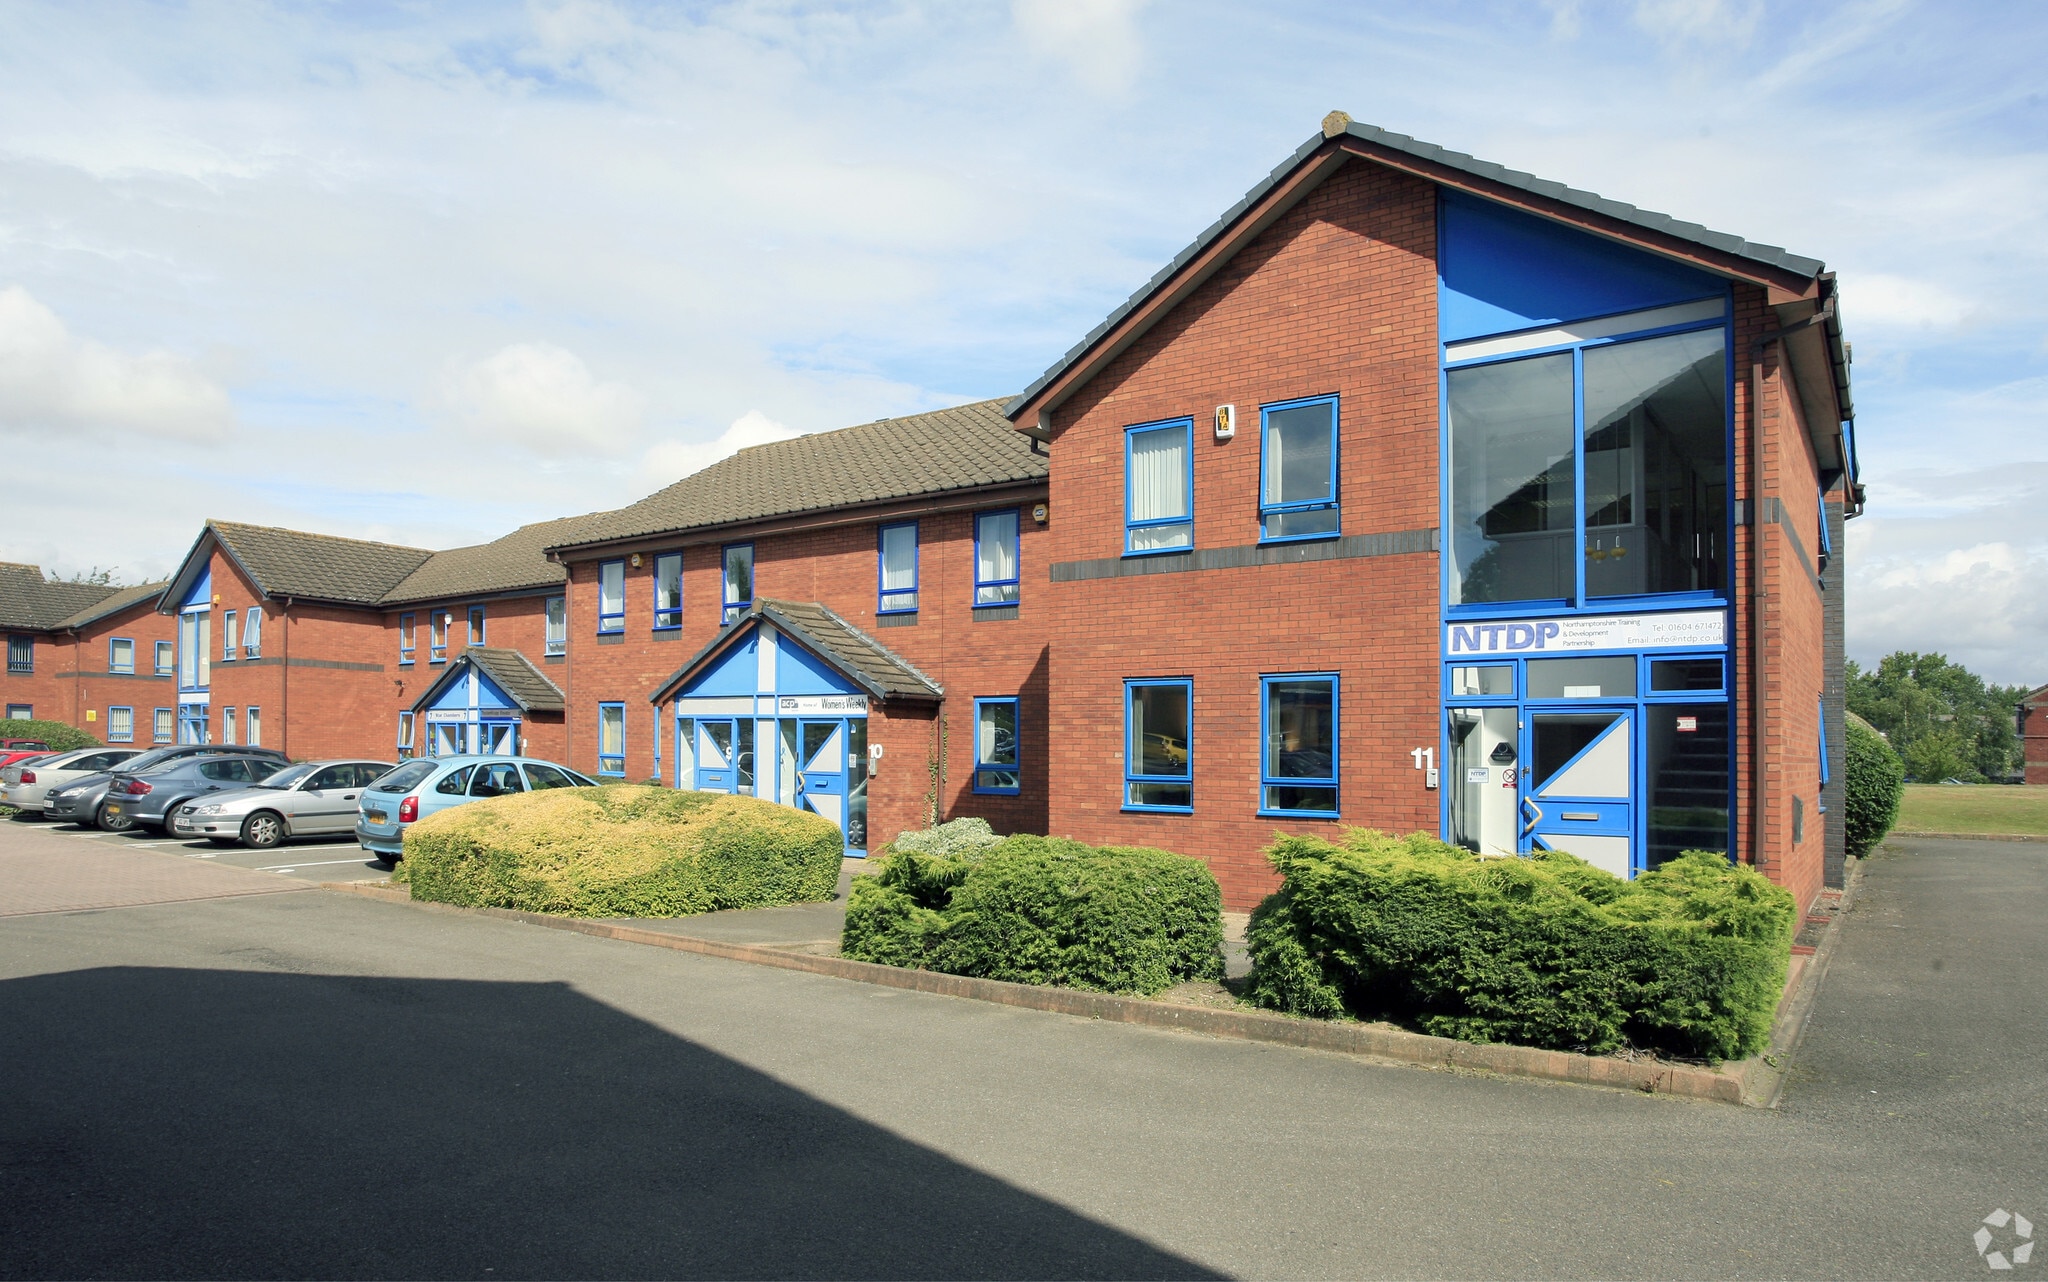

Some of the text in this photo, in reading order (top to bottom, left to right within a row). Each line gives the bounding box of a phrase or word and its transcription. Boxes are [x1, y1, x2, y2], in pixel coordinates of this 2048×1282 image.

[1563, 620, 1616, 628] Northamptonshire
[1668, 623, 1692, 631] 01604
[1452, 622, 1559, 652] NTDP
[1562, 639, 1595, 647] Partnership
[868, 744, 883, 759] 10
[1410, 747, 1434, 770] 11
